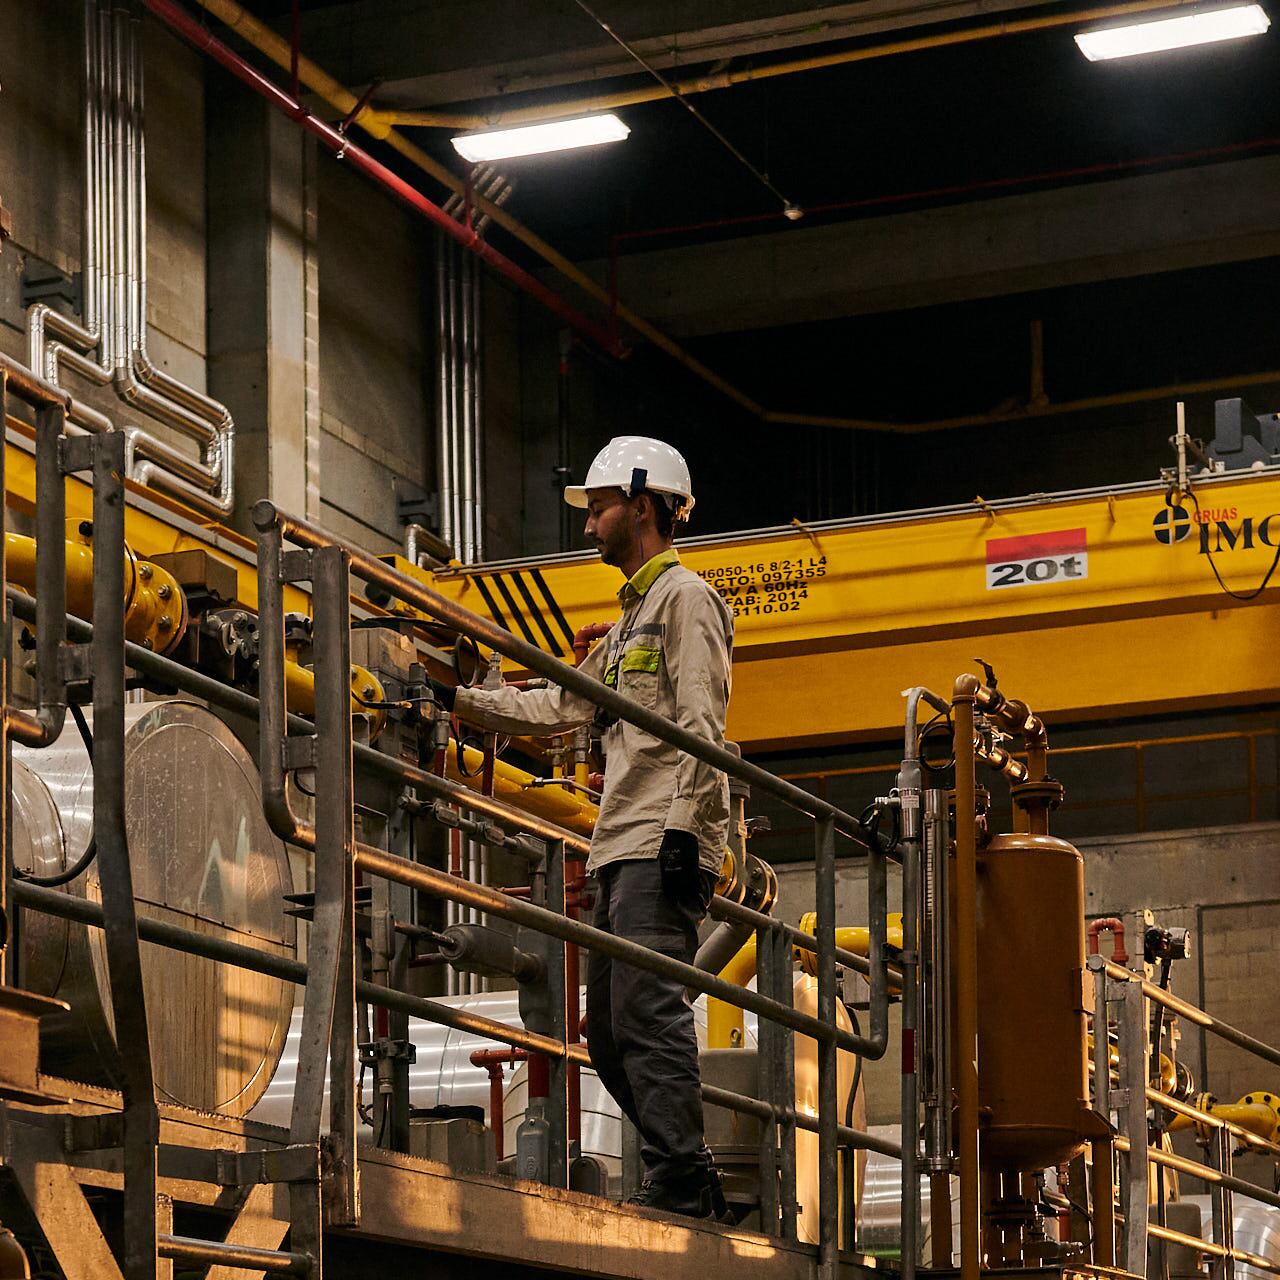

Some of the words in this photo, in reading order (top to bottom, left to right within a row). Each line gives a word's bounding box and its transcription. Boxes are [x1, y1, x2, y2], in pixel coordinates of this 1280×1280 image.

[1193, 507, 1238, 523] GRUAS
[770, 559, 803, 572] 8/2-1
[810, 556, 827, 567] L4
[992, 556, 1082, 587] 20t
[762, 567, 826, 583] 097355
[746, 586, 758, 595] A
[764, 580, 808, 593] 60Hz
[767, 590, 808, 603] 2014
